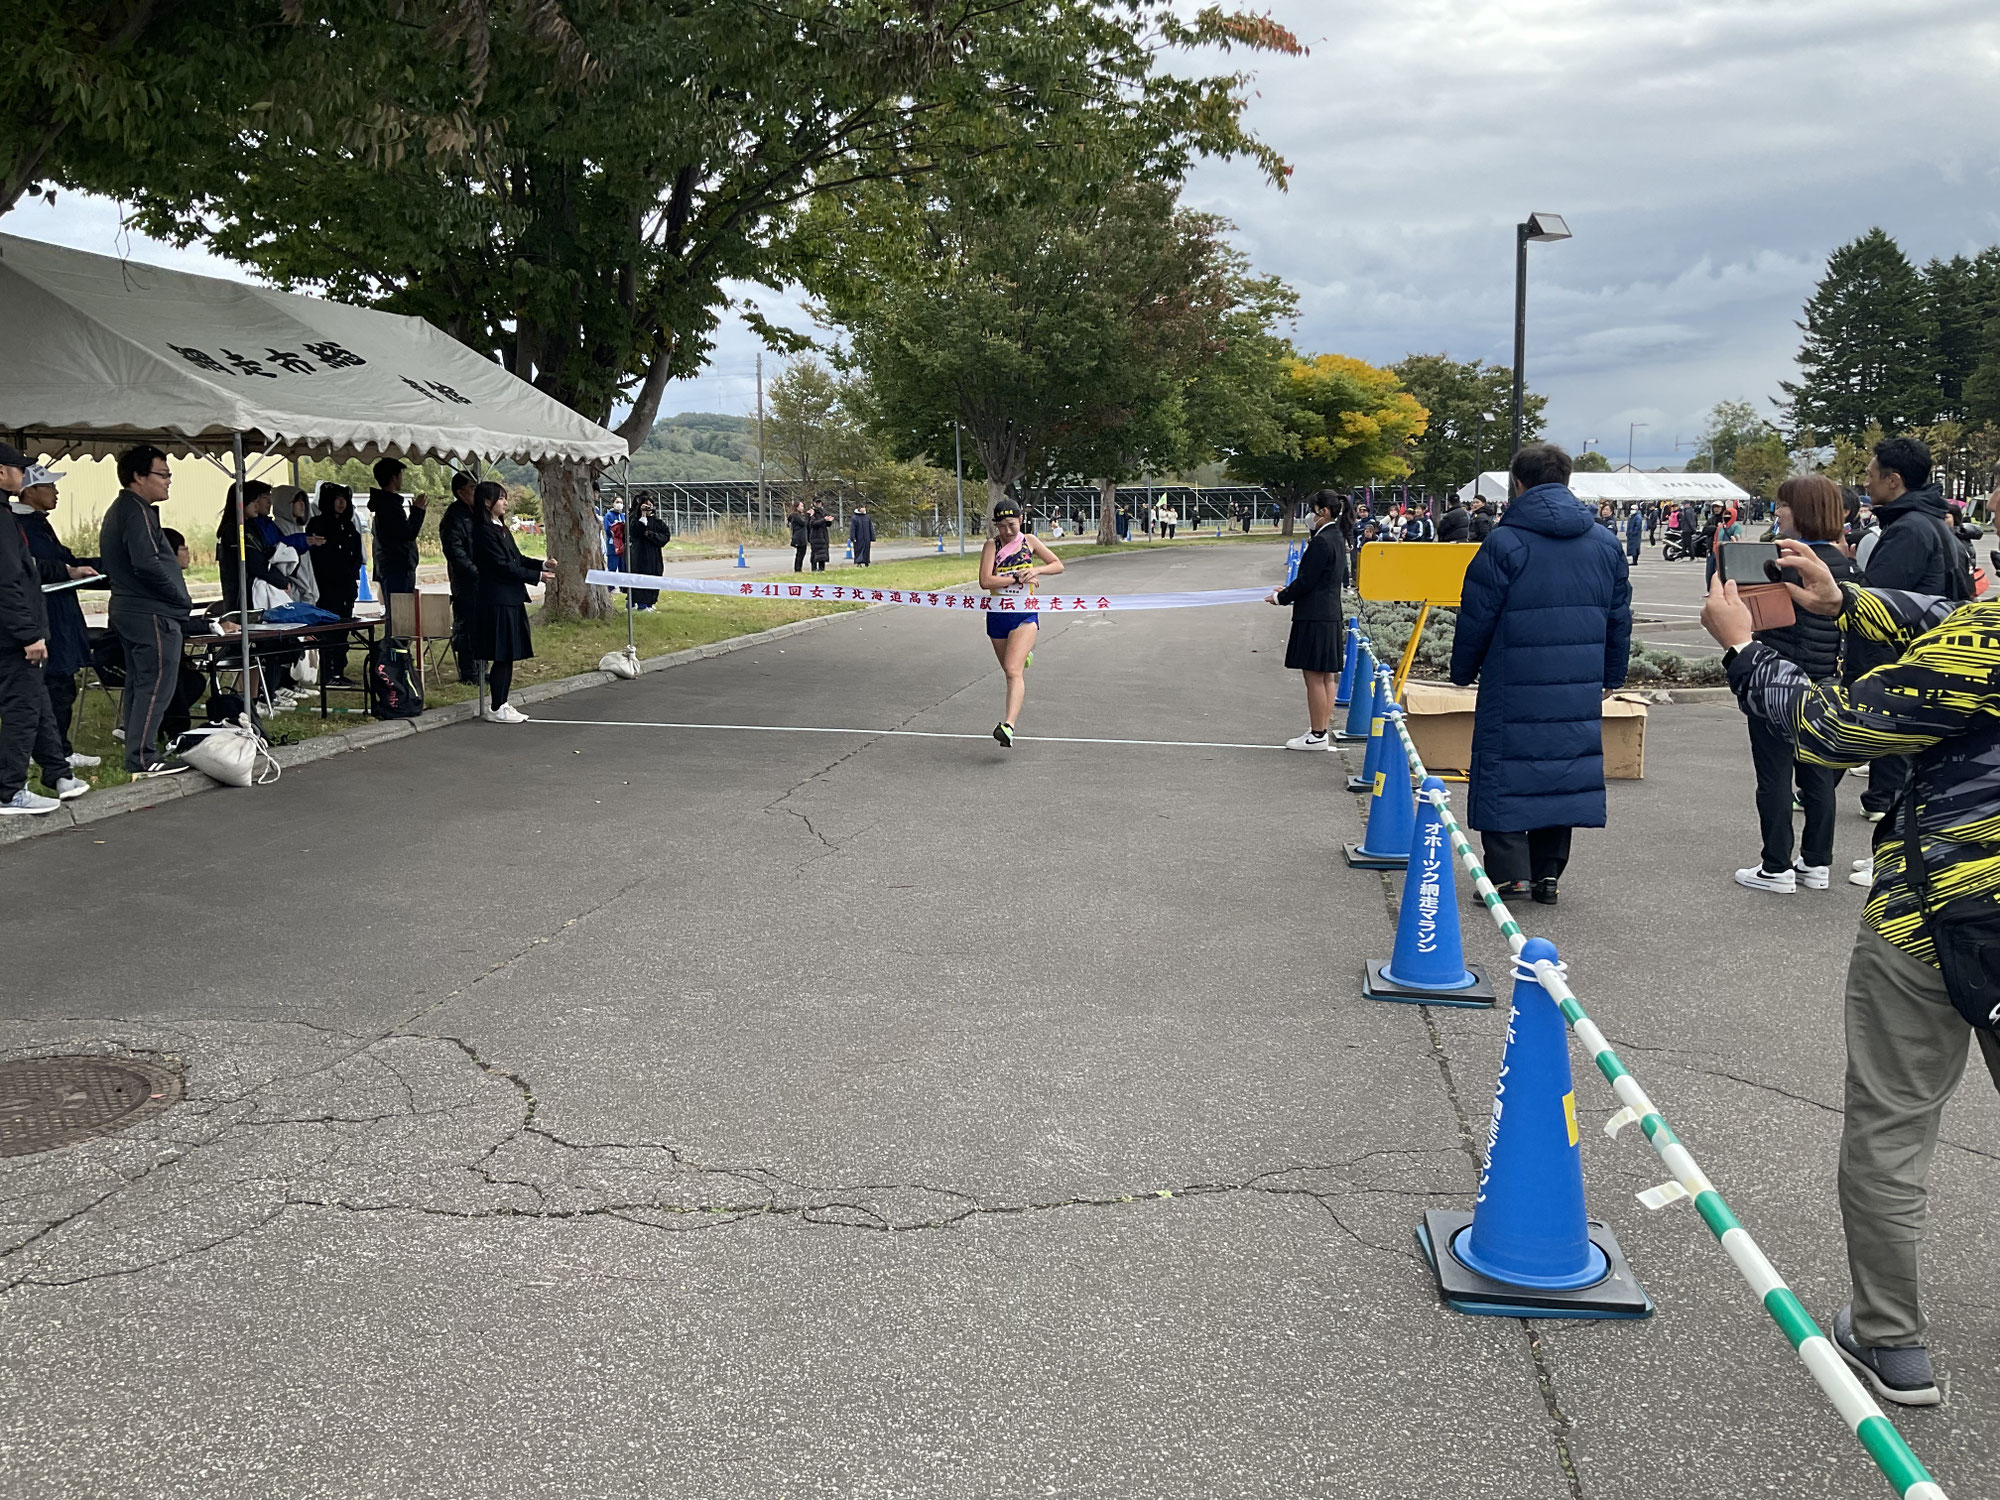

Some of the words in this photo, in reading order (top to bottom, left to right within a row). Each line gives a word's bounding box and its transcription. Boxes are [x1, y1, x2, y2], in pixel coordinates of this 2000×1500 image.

[1416, 822, 1444, 954] オホーツク網走マラソン
